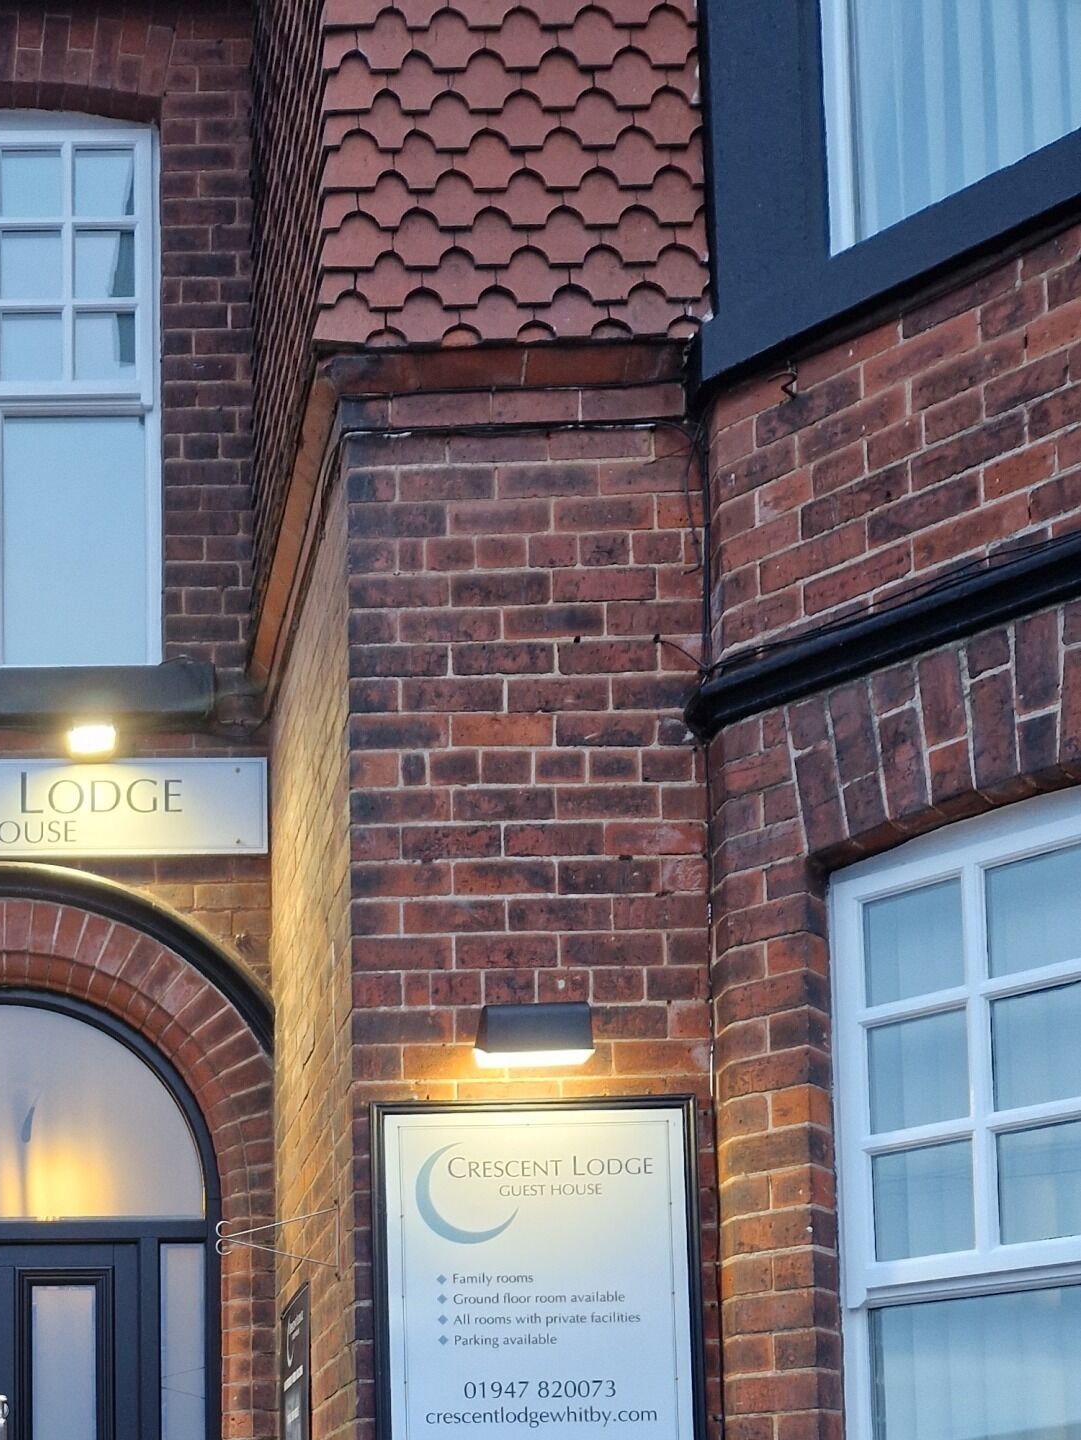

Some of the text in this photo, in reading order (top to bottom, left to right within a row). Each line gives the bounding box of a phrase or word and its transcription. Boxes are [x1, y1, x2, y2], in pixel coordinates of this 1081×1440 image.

[18, 770, 184, 815] LODGE
[447, 1155, 654, 1179] CRESCENT LODGE
[498, 1182, 603, 1197] GUEST HOUSE
[452, 1272, 534, 1287] Family rooms
[453, 1291, 626, 1305] Ground floor room available
[453, 1311, 641, 1327] All rooms with private facilities
[453, 1333, 558, 1348] Parking available
[464, 1379, 617, 1399] 01947 820073
[425, 1406, 658, 1428] crescentlodgewhitby.com
